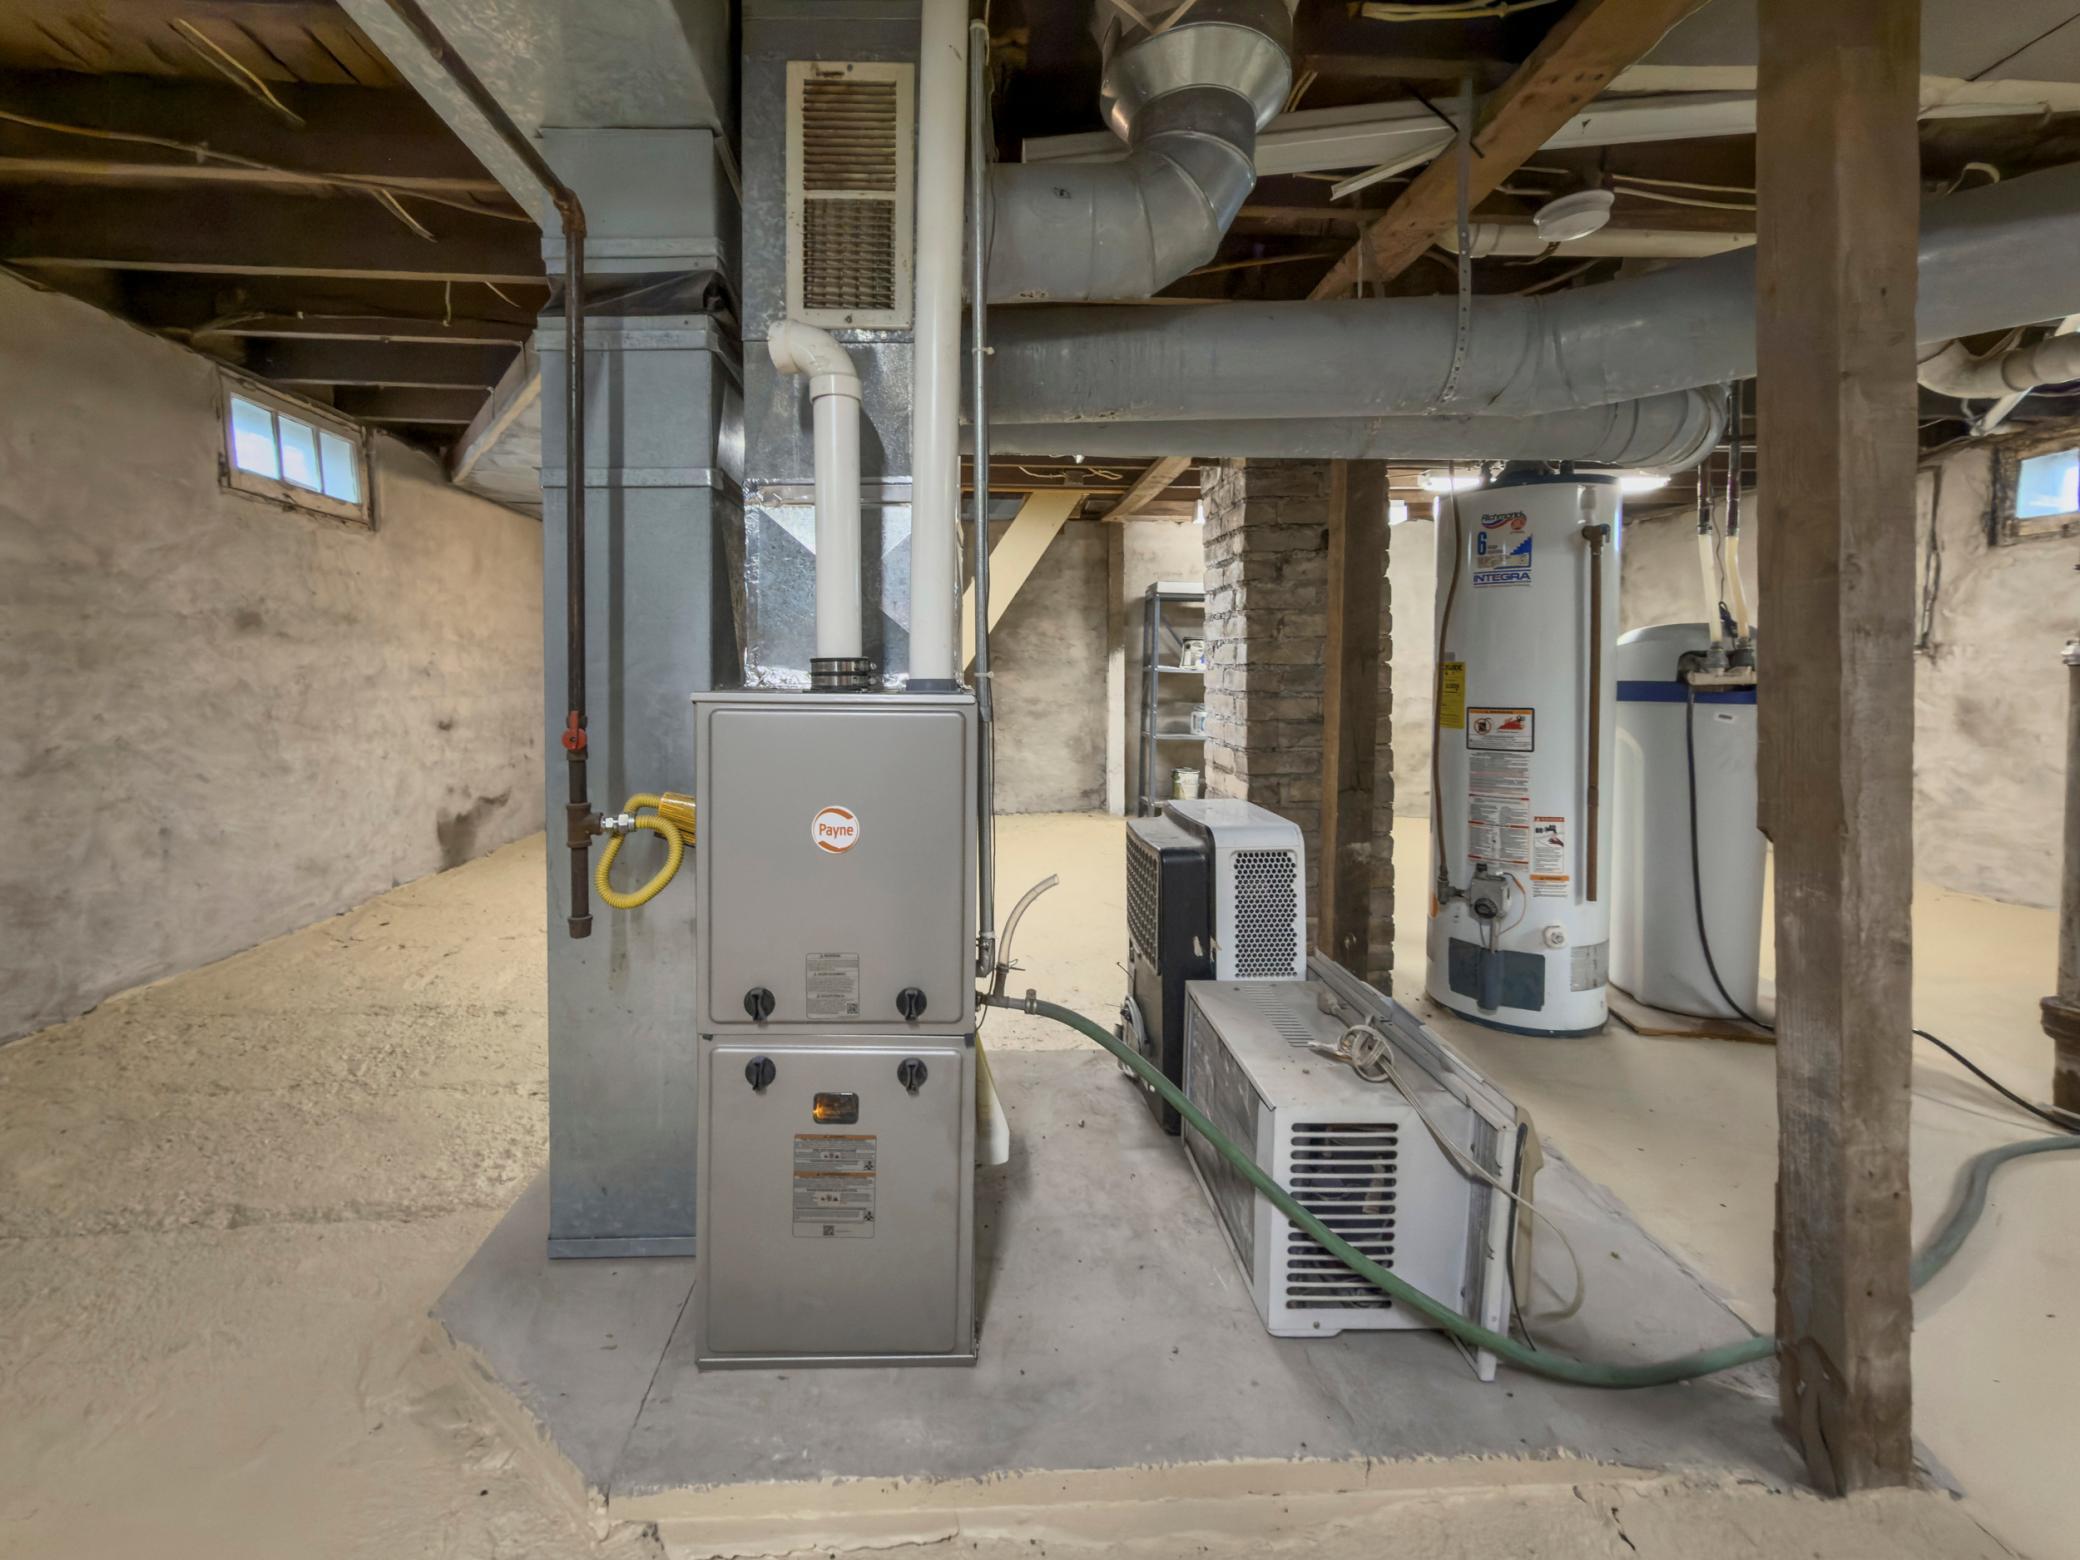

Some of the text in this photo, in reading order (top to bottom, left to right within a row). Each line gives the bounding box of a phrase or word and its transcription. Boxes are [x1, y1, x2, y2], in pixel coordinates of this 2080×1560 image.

[1477, 531, 1488, 556] 6
[1472, 572, 1531, 583] INTEGRA
[818, 823, 854, 840] Payne
